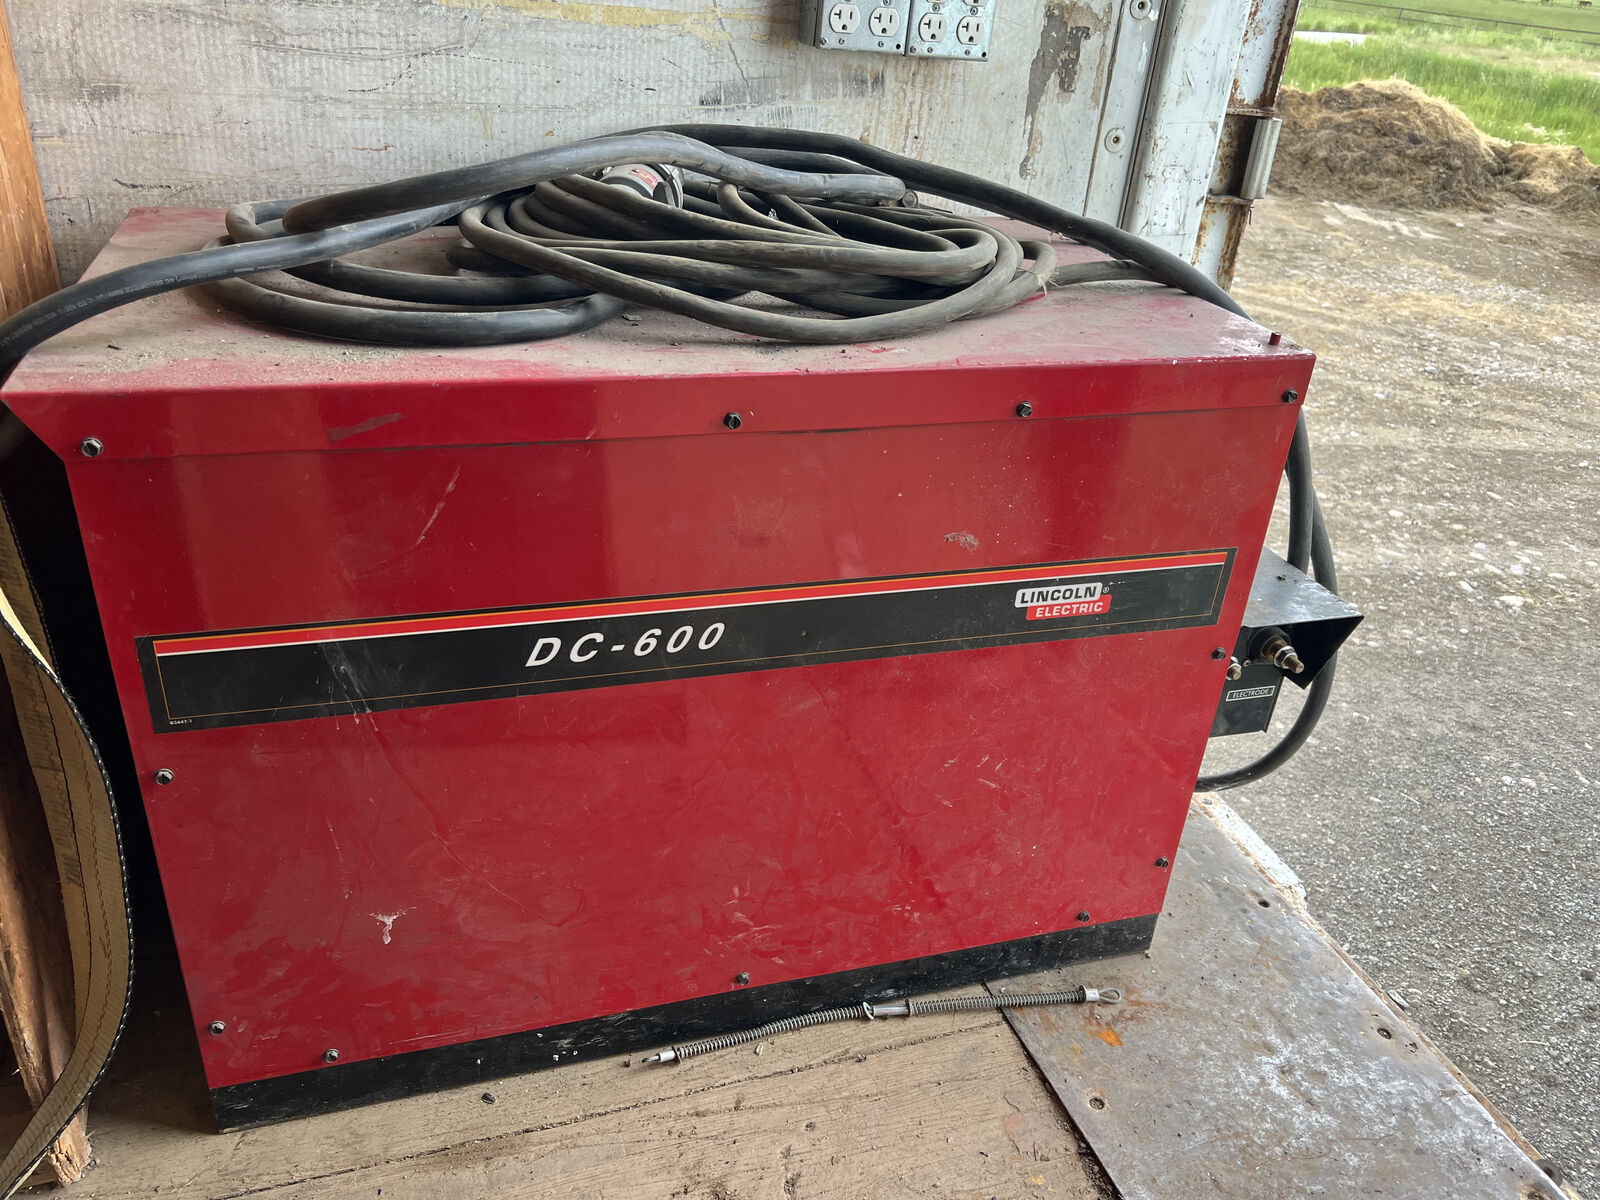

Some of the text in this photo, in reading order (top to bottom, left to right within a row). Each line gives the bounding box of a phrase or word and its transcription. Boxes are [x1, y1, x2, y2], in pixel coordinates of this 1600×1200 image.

[1020, 586, 1097, 604] LINCOLN
[1035, 602, 1104, 618] ELECTRIC
[525, 622, 726, 667] DC-600
[1232, 688, 1270, 699] ELECTRODE
